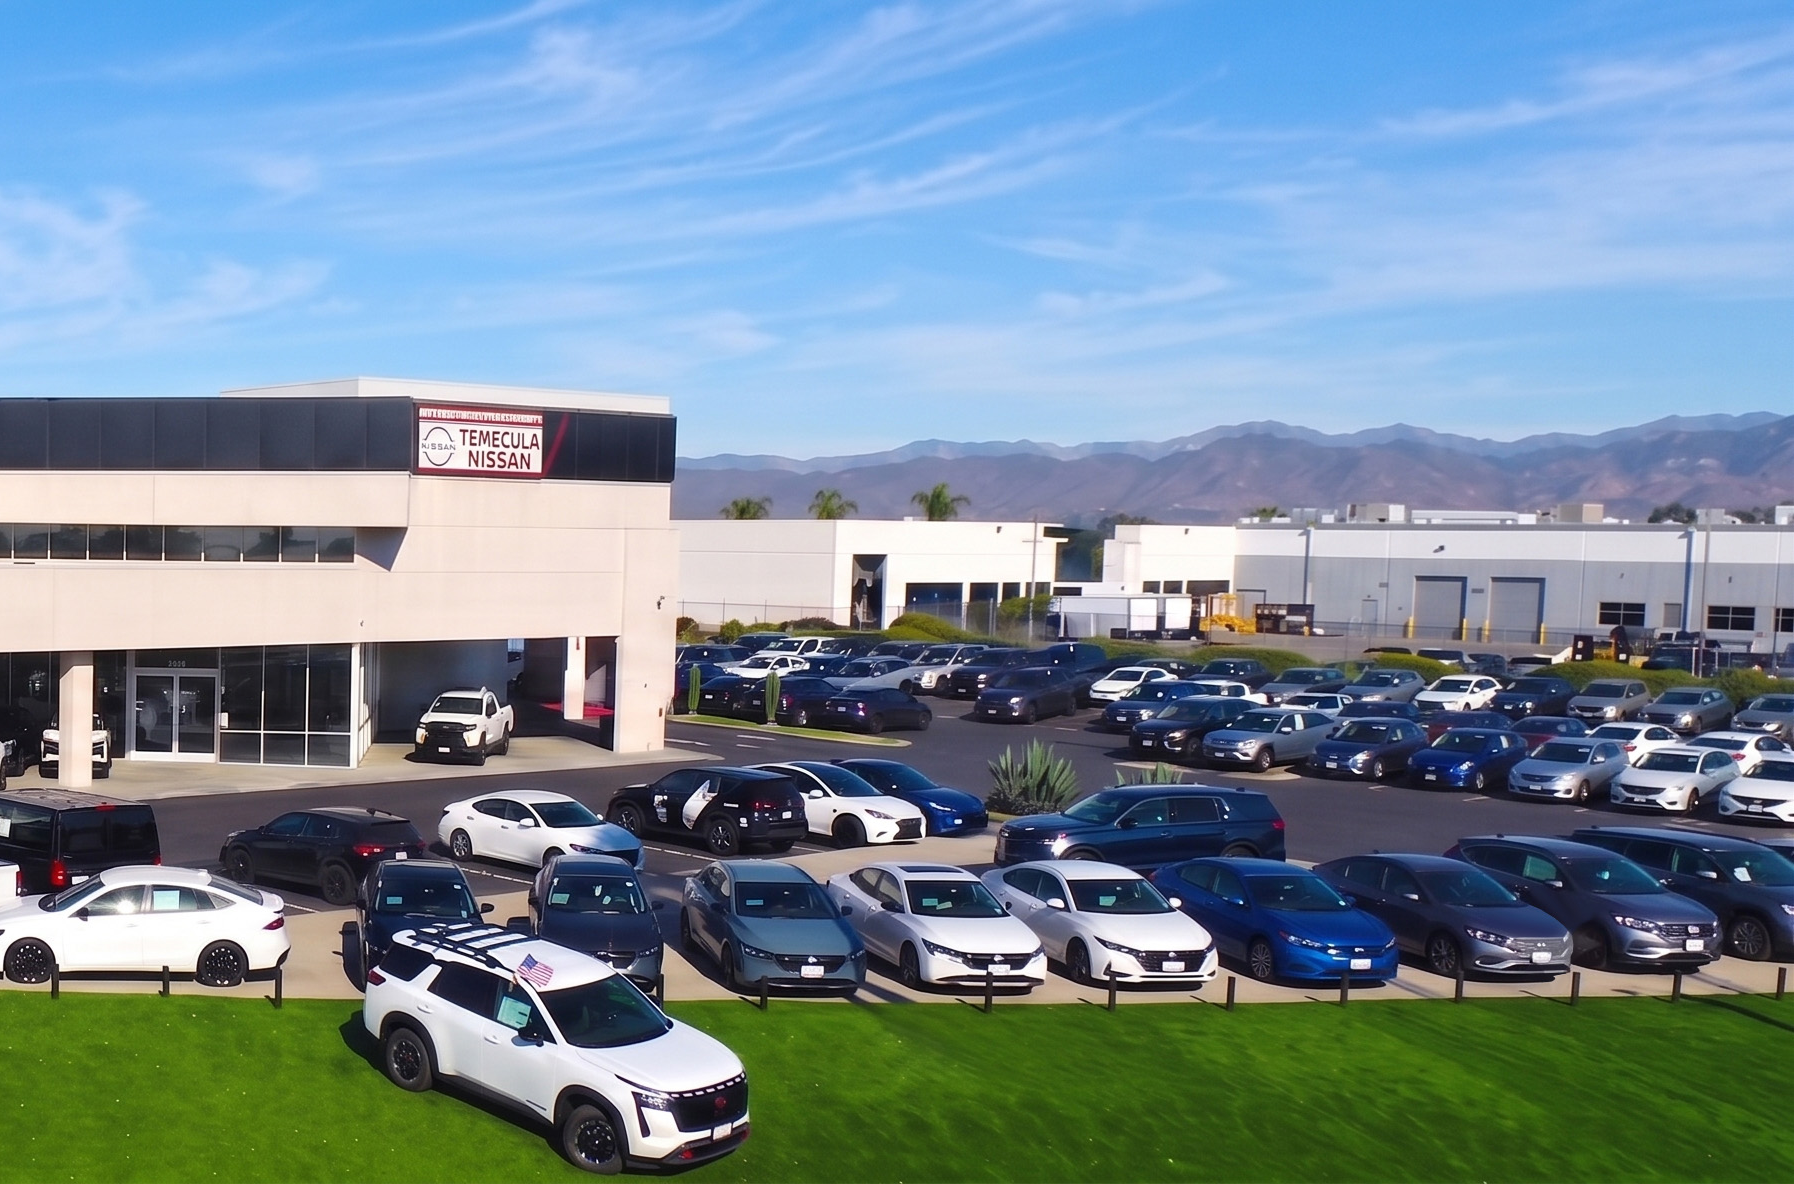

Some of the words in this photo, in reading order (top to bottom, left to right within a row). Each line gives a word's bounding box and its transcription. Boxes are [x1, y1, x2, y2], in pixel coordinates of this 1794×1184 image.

[421, 443, 455, 451] NISSAN
[459, 429, 539, 450] TEMECULA
[468, 450, 531, 470] NISSAN
